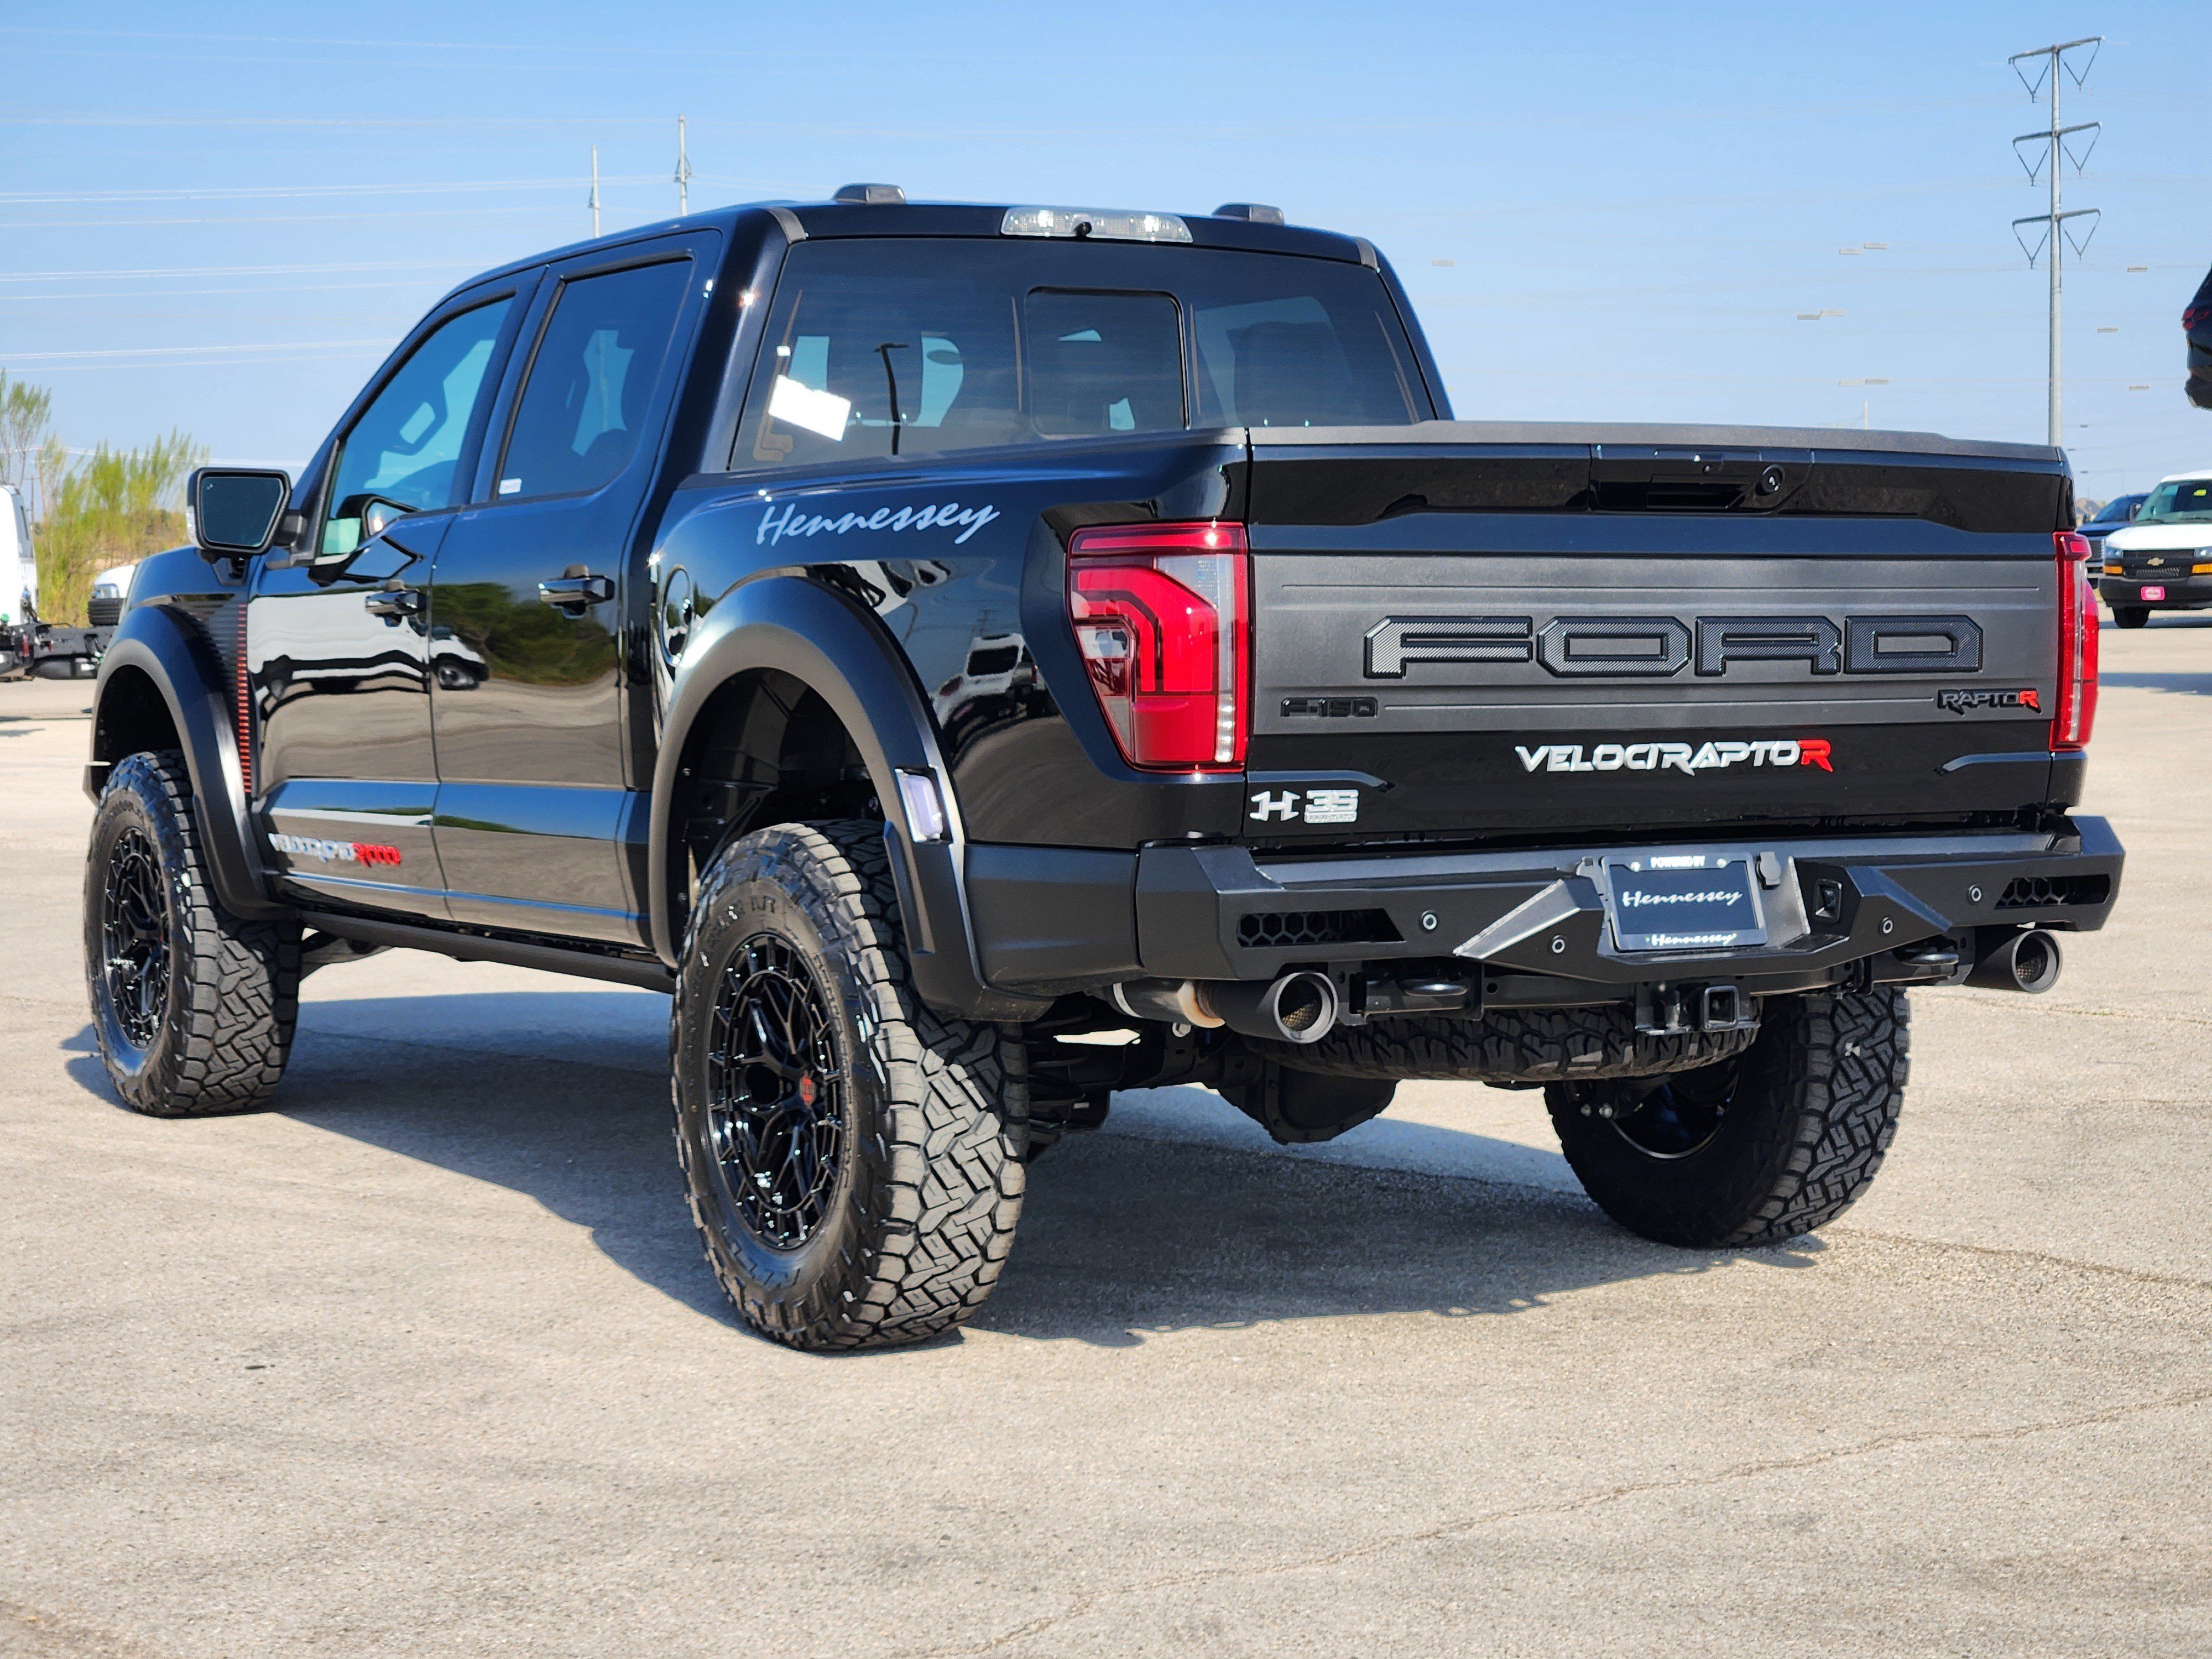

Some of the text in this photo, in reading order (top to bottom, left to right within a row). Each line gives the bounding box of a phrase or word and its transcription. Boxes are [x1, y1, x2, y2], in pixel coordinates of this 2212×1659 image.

[756, 502, 1001, 546] Hennessey
[1364, 615, 1984, 679] FORD
[1280, 697, 1378, 717] F-150
[1937, 688, 2041, 716] RAPTOR
[1515, 739, 1833, 776] VELOCIRAPTOR
[1305, 789, 1359, 812] 35
[1623, 891, 1743, 907] Hennessey
[1651, 933, 1736, 946] Hennessey
